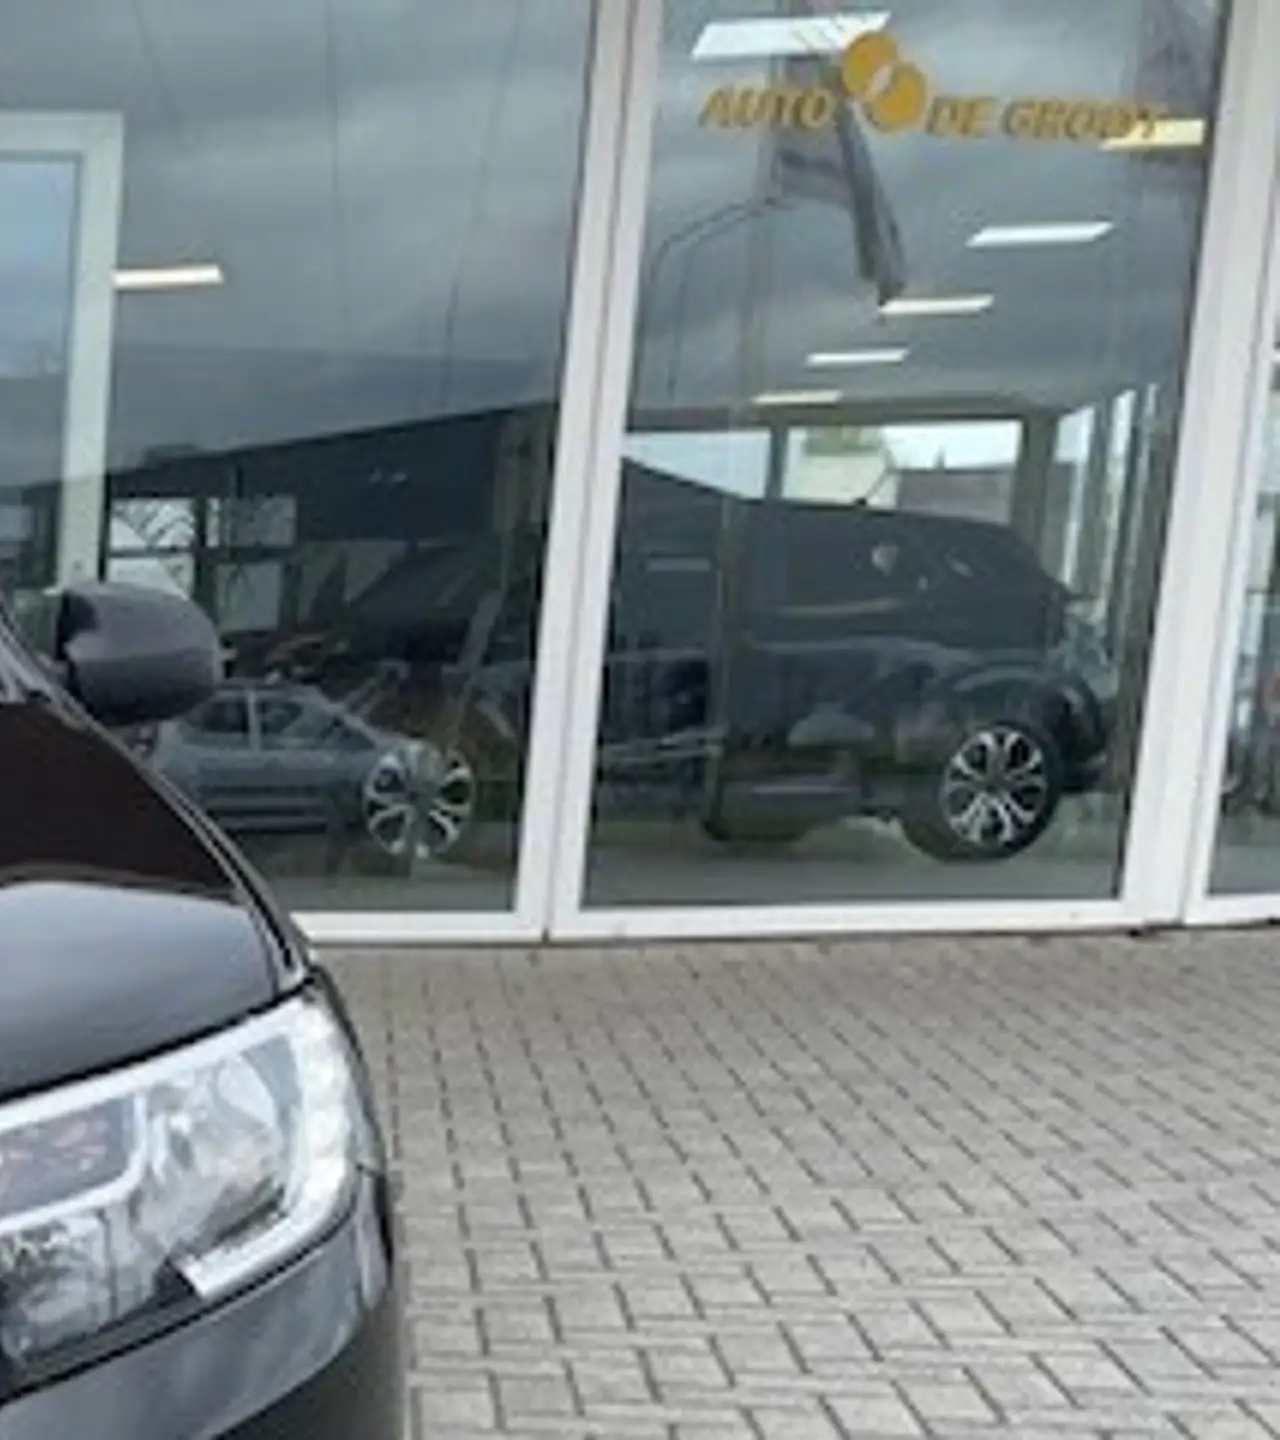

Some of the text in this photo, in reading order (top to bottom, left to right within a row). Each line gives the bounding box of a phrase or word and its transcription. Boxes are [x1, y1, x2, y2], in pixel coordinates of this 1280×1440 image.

[697, 84, 1162, 144] AUTO DE GROOT
